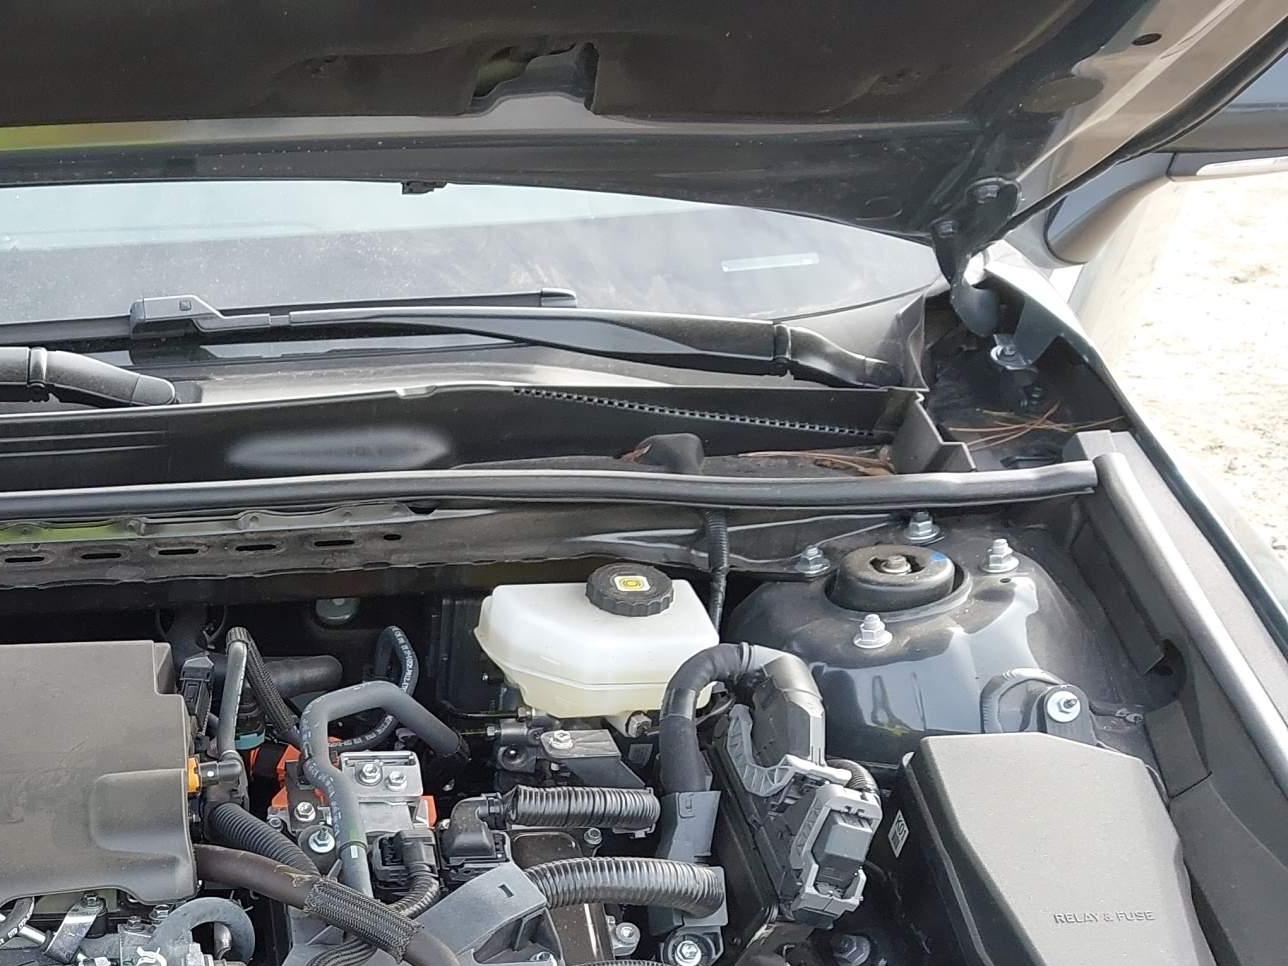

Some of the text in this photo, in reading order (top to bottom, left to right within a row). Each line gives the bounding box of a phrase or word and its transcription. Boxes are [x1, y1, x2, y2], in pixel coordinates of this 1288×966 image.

[1053, 910, 1155, 924] RELAY & FUSE
